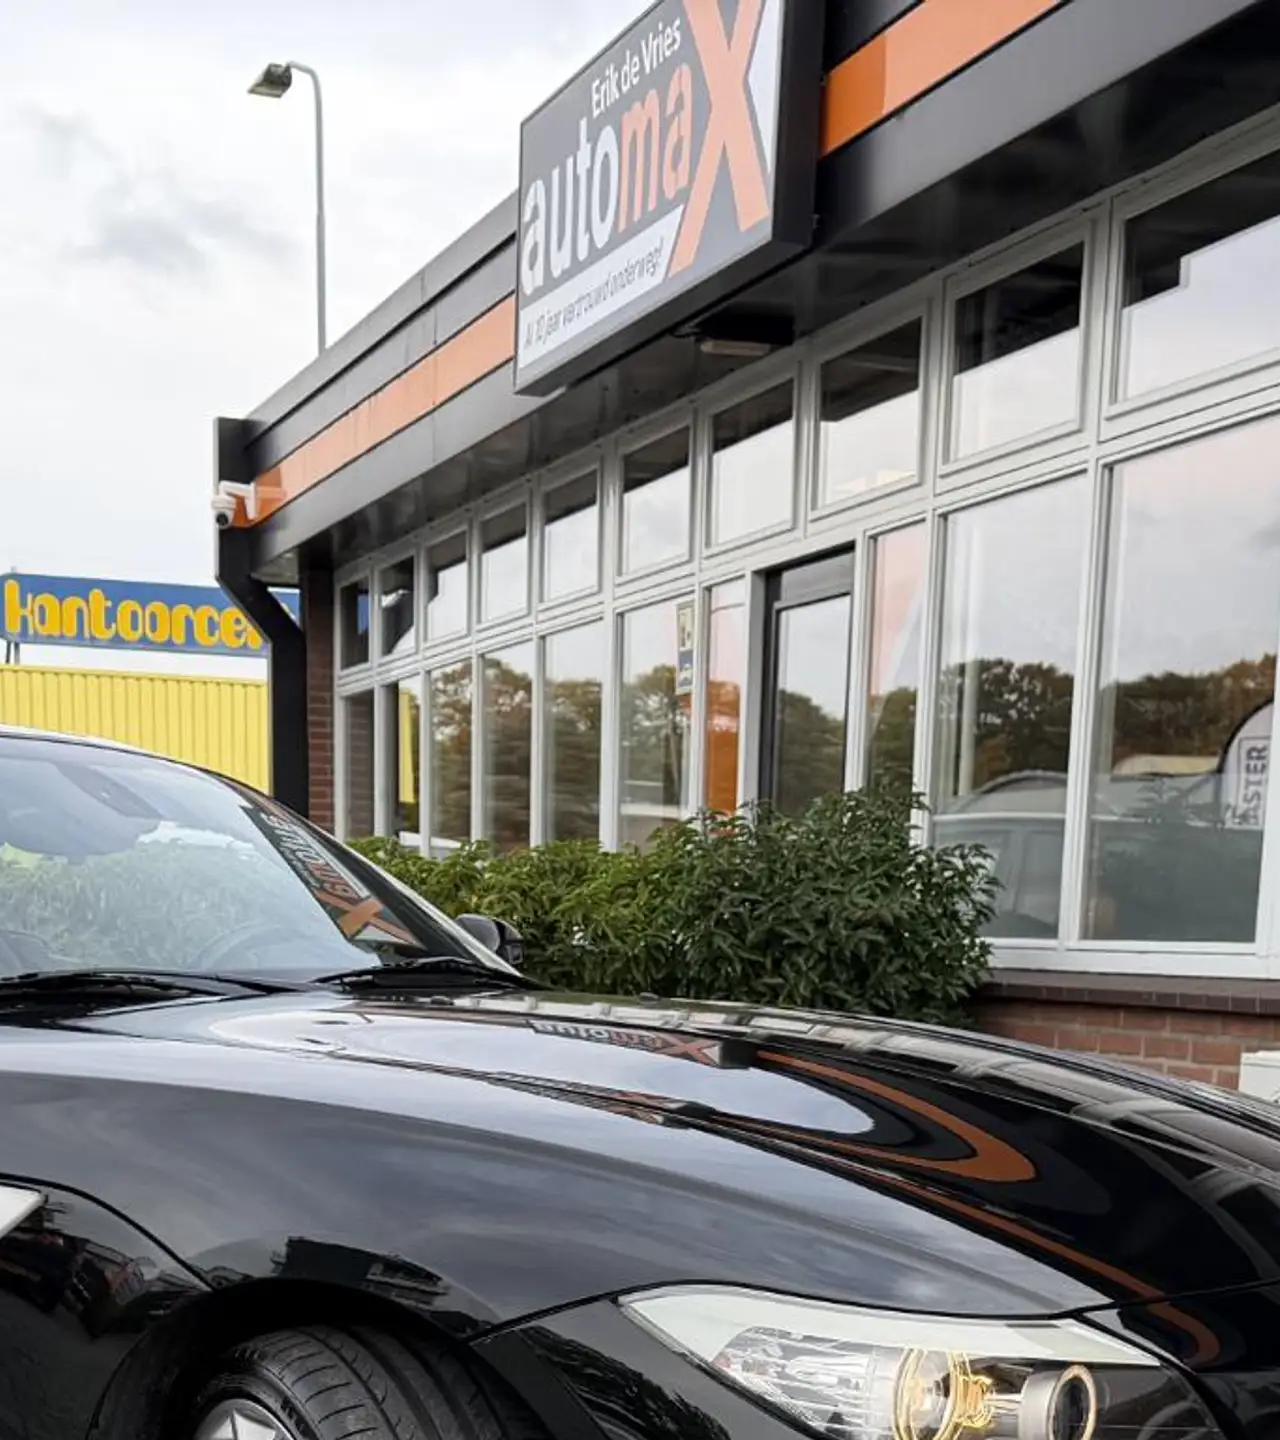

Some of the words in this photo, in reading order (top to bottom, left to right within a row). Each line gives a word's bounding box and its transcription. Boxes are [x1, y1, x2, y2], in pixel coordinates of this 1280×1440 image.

[591, 68, 619, 119] Erik
[621, 50, 640, 94] de
[641, 17, 682, 75] Vries
